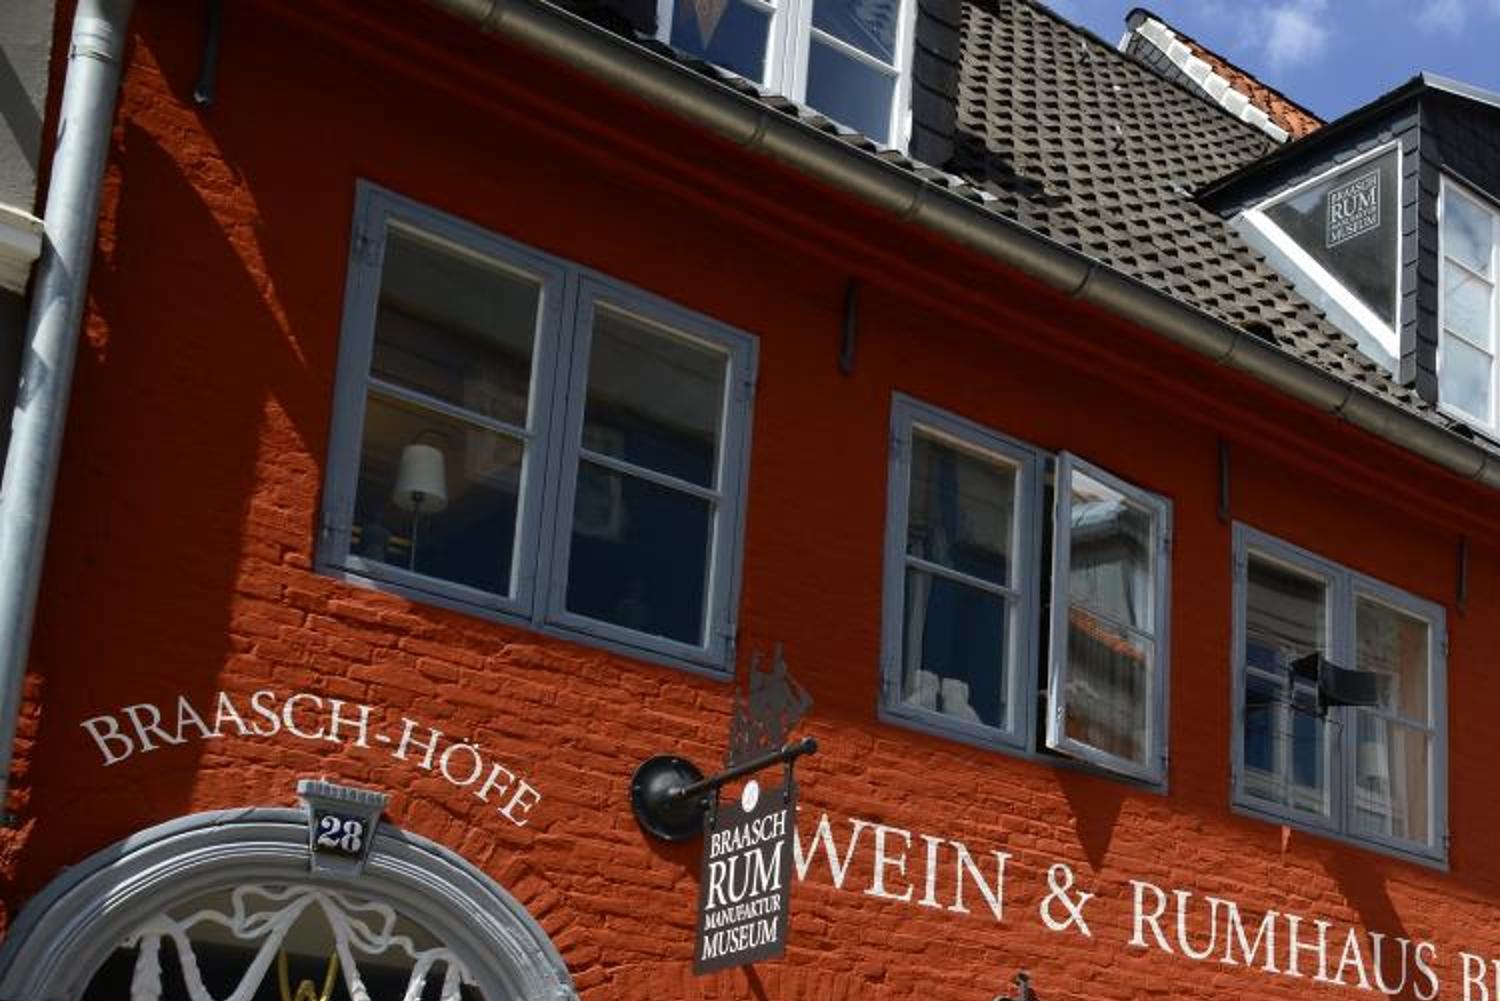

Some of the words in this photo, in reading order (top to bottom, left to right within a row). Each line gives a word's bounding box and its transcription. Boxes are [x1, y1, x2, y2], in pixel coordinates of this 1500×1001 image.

[1331, 187, 1377, 222] RUM
[81, 690, 541, 827] BRAASCH-HÖFE
[317, 815, 364, 852] 28
[709, 810, 787, 858] BRAASCH
[705, 841, 785, 911] RUM
[704, 893, 781, 931] MANUFAKTUR
[793, 806, 1011, 922] WEIN
[1038, 863, 1096, 937] &
[1128, 879, 1441, 1001] RUMHAUS
[701, 916, 779, 961] MUSEUM
